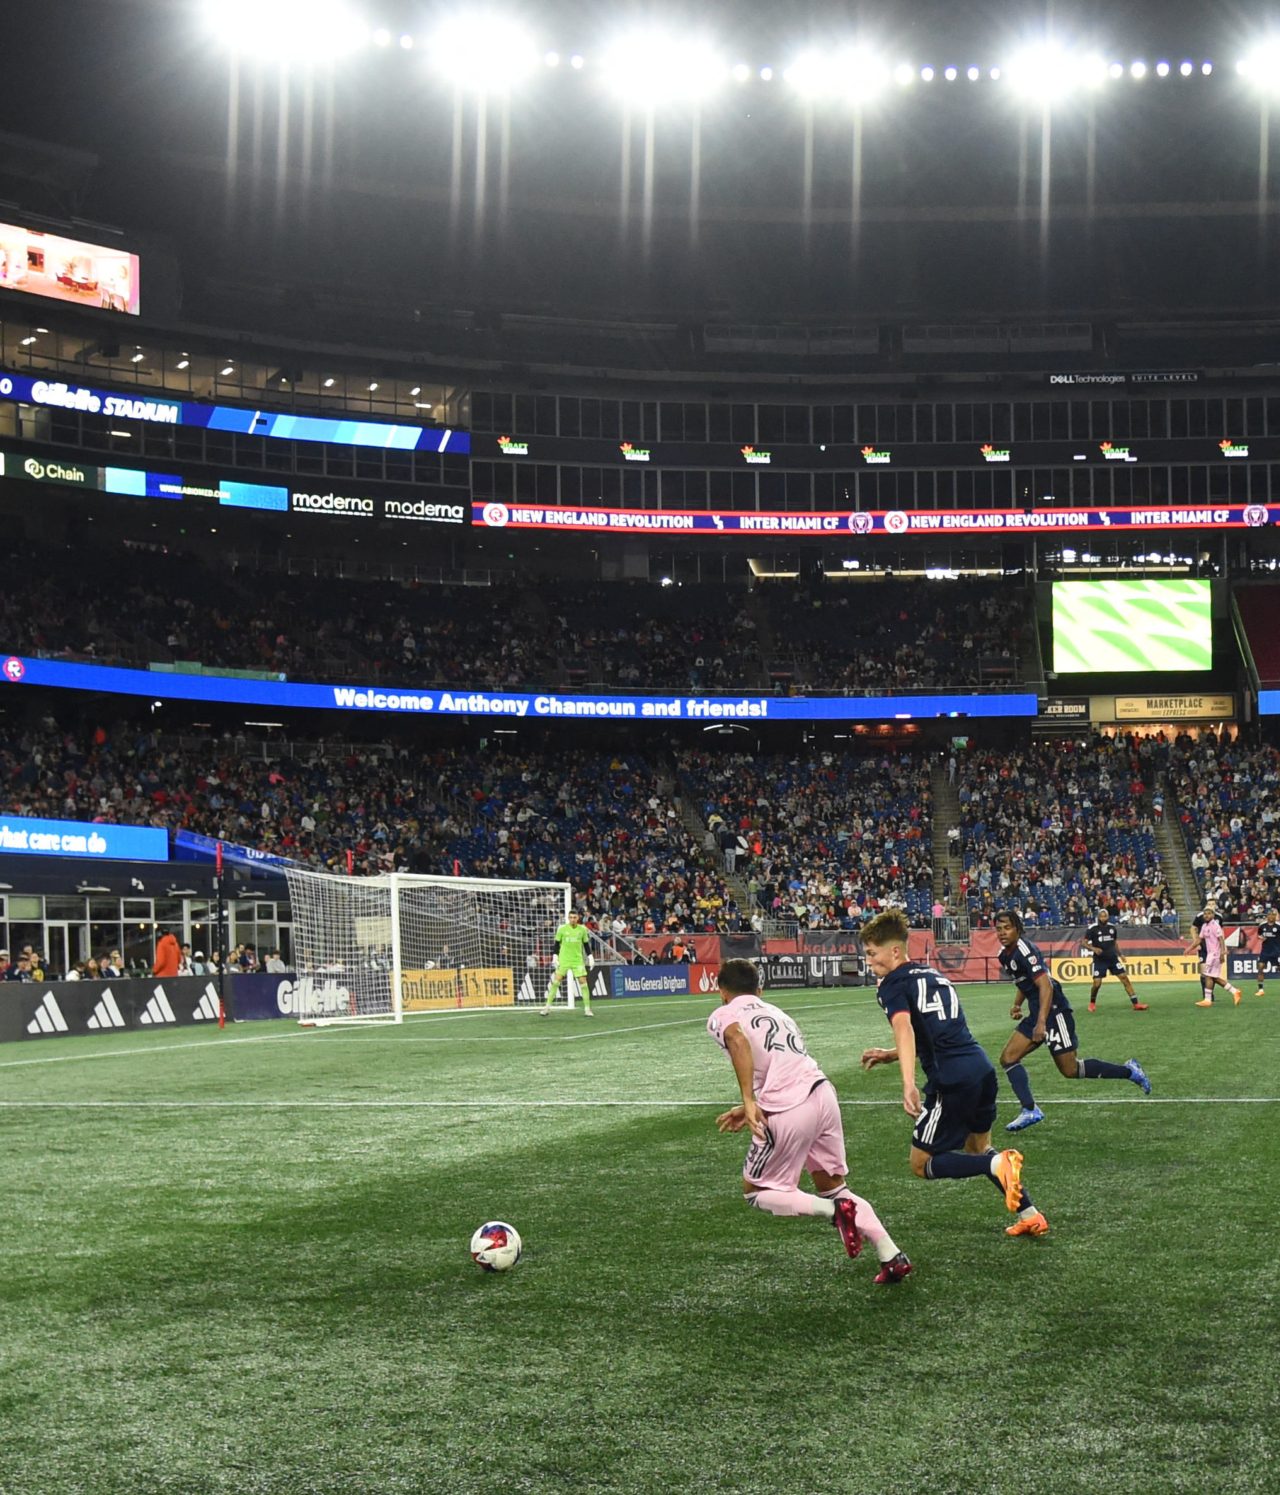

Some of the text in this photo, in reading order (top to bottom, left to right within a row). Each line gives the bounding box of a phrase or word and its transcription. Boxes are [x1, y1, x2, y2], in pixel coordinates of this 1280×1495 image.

[1050, 374, 1125, 385] DELL Technologies
[103, 397, 178, 423] STADIUM
[46, 463, 84, 482] Chain
[292, 493, 373, 511] moderna
[384, 500, 465, 518] moderna
[512, 509, 693, 528] NEW ENGLAND REVOLUTION
[739, 516, 839, 529] INTER MIAMI CF
[910, 512, 1088, 528] NEW ENGLAND REVOLUTION
[1131, 510, 1229, 524] INTER MIAMI CF
[334, 688, 768, 717] Welcome Anthony Chamoun and friends!
[1064, 704, 1086, 714] ROOM
[1146, 698, 1203, 709] MARKETPLACE
[1162, 709, 1186, 717] EXPRESS
[29, 832, 60, 851] care
[62, 834, 87, 852] can
[88, 832, 106, 853] do
[803, 943, 857, 954] NGLAND
[1057, 959, 1159, 982] Contntal
[400, 973, 509, 1008] ontinental TIRE
[625, 976, 687, 992] Mass General Brigham
[277, 977, 350, 1014] Gillette
[916, 976, 960, 1021] 47
